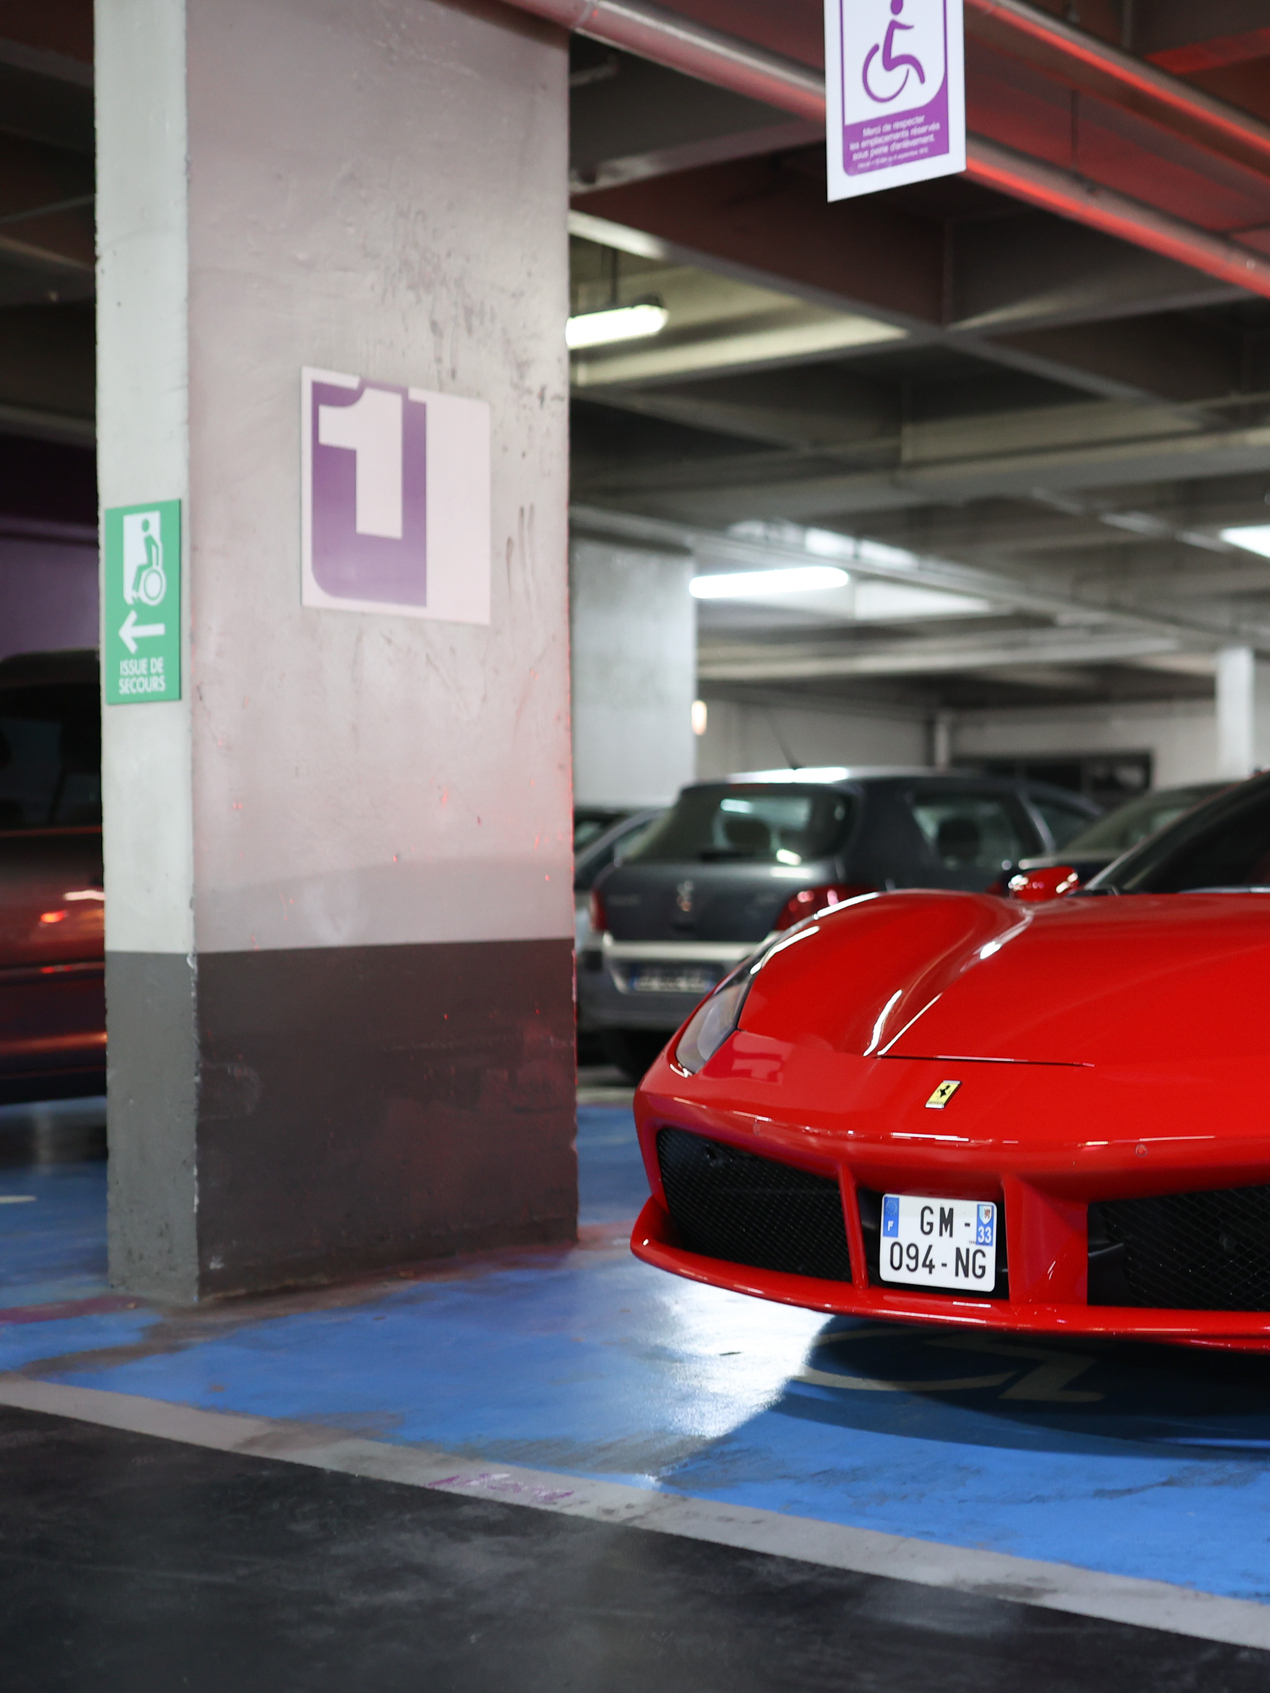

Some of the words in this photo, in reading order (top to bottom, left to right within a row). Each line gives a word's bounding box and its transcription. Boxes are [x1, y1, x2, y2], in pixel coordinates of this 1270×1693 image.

[882, 122, 892, 134] de
[119, 657, 148, 676] ISSUE
[150, 656, 164, 675] DE
[118, 675, 167, 694] SECOURS
[977, 1226, 992, 1244] 33
